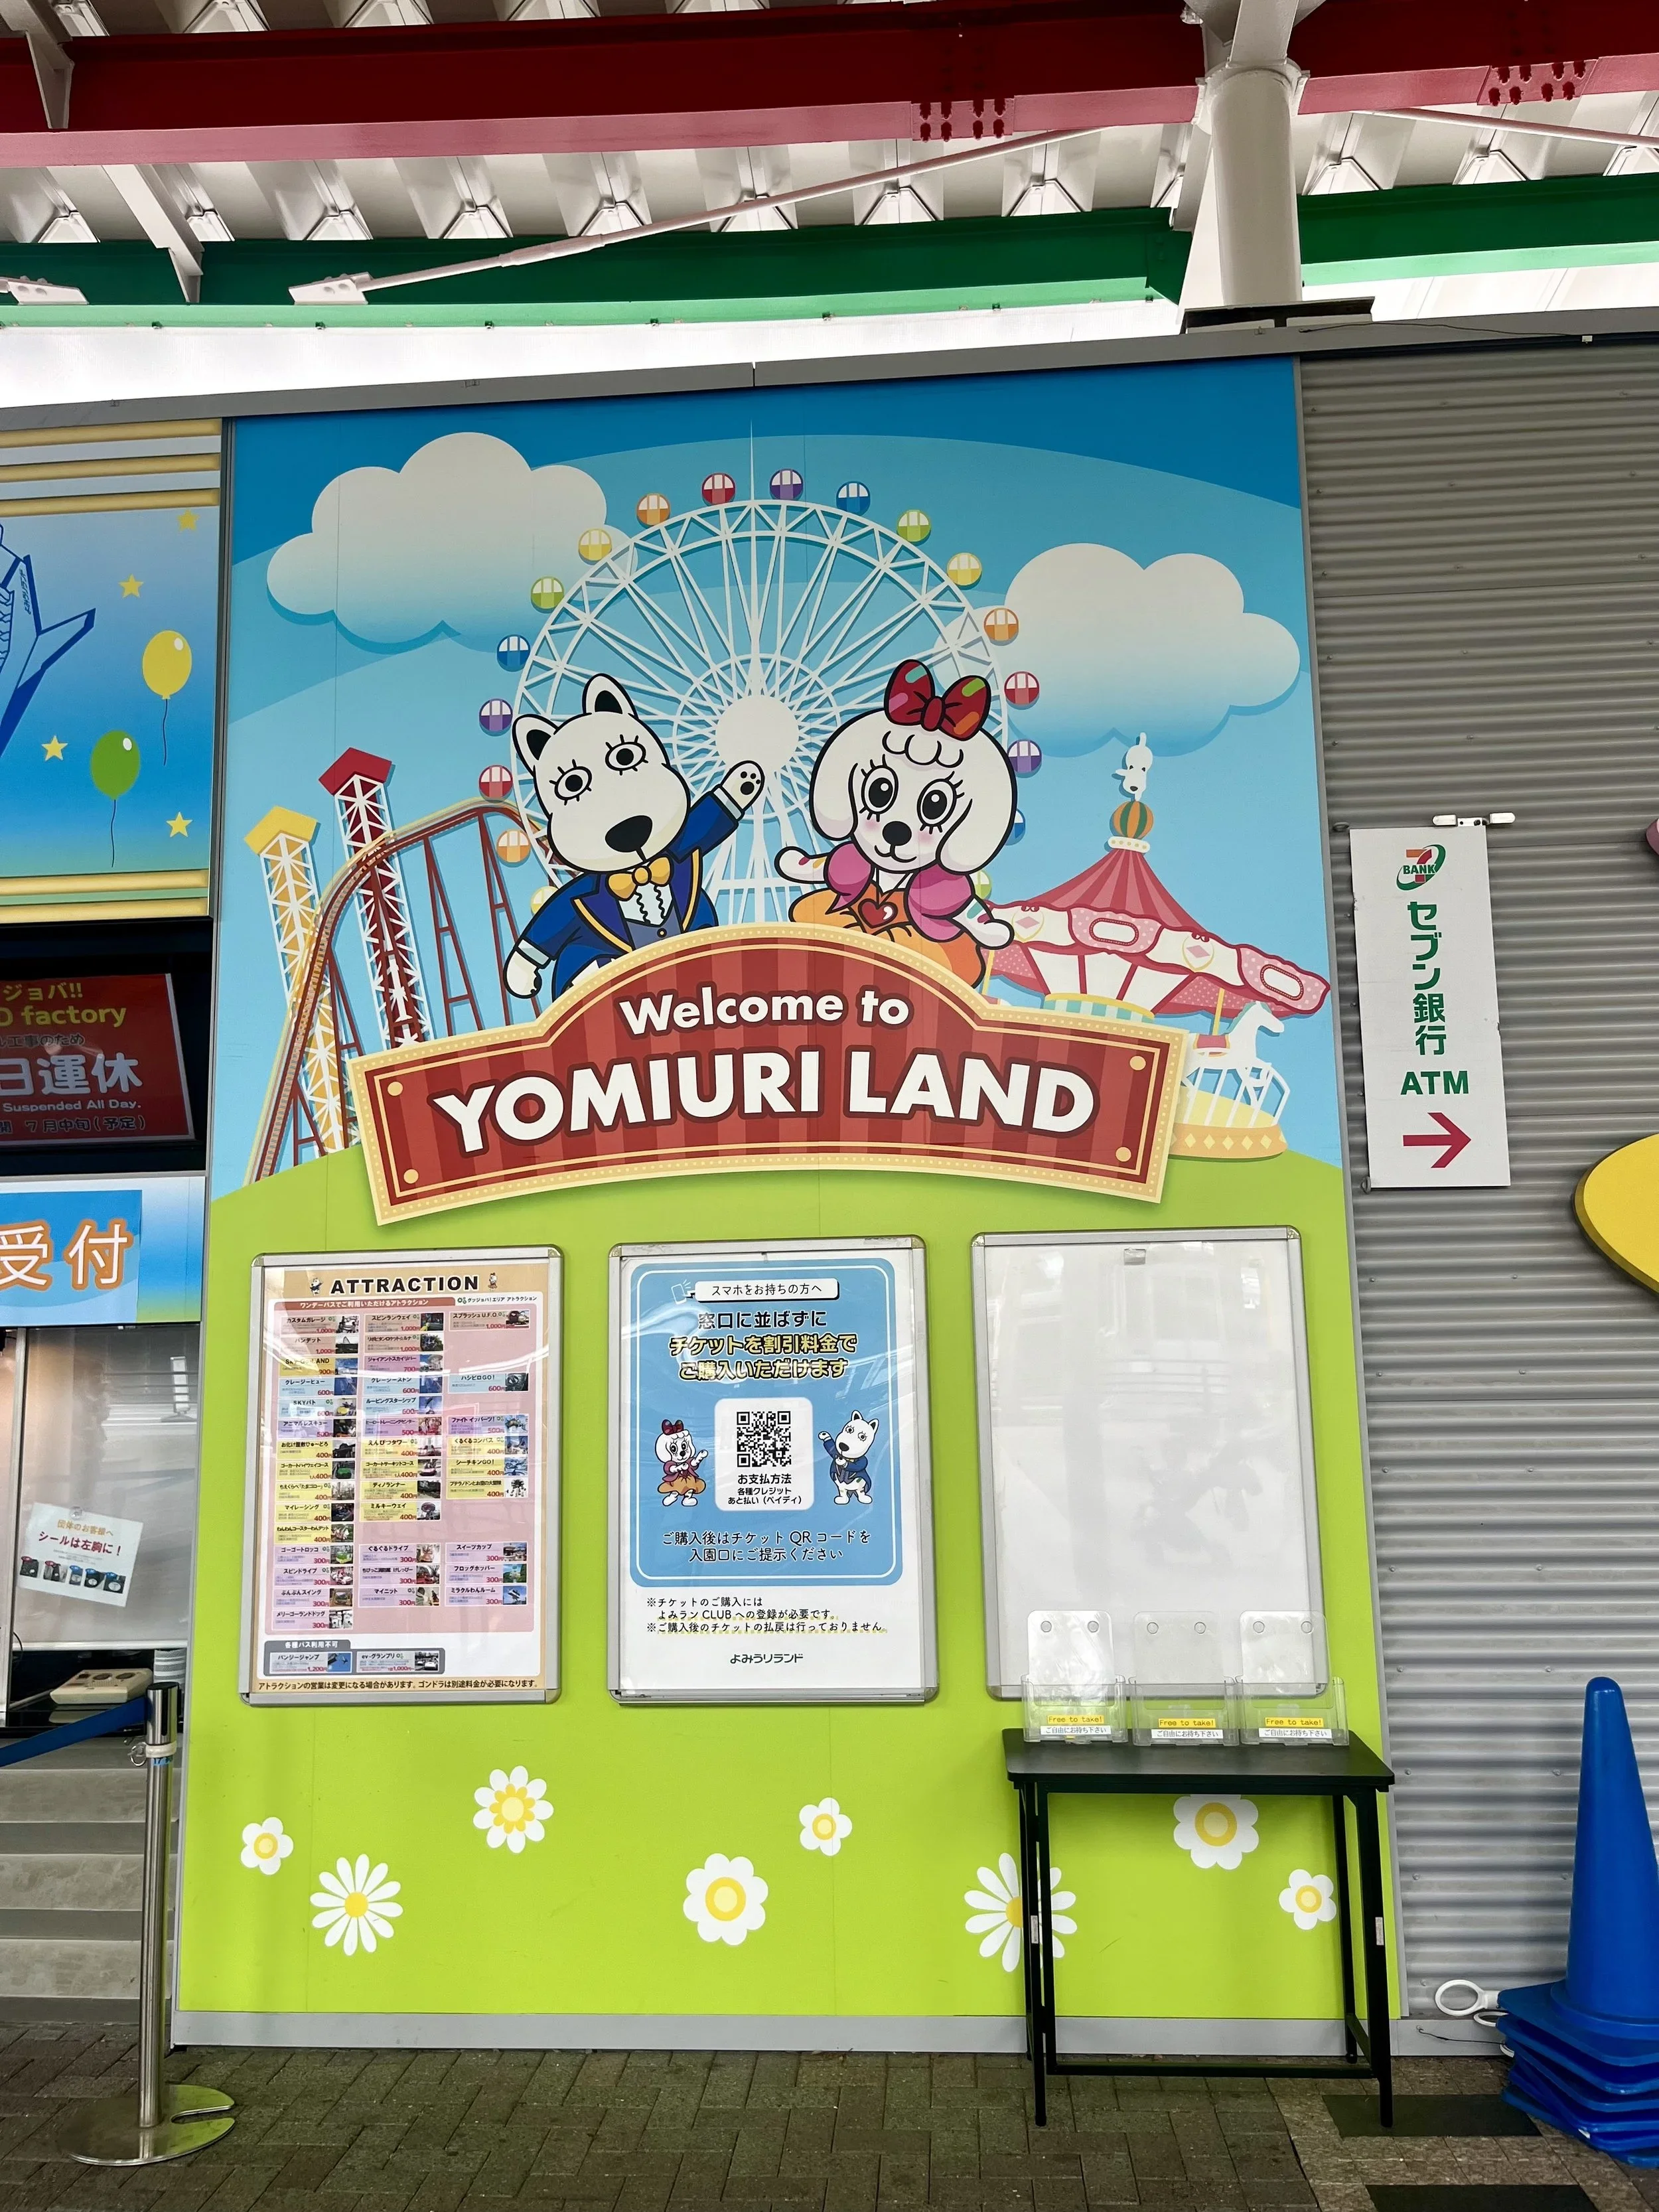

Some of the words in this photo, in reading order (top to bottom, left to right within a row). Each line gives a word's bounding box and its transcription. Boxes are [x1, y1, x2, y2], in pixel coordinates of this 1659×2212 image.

[1403, 864, 1435, 874] BANK
[1407, 901, 1446, 1056] セブン銀行
[21, 1005, 127, 1028] factory
[618, 986, 844, 1036] Welcome
[860, 986, 910, 1026] to
[1400, 1070, 1470, 1095] ATM
[3, 1100, 82, 1113] Suspended
[87, 1099, 105, 1110] All
[109, 1098, 142, 1110] Day.
[433, 1050, 820, 1153] YOMIURI
[848, 1051, 1096, 1134] LAND
[0, 1222, 130, 1288] 受付
[330, 1275, 479, 1295] ATTRACTION
[711, 1282, 822, 1297] スマホをお持ちの方へ
[300, 1299, 429, 1309] ワンデーパスでご利用いただけるアトラクション
[698, 1310, 827, 1329] 窓口に並ばずに
[670, 1334, 857, 1357] チケットを割引料金で
[679, 1359, 848, 1382] ご購入いただけます
[737, 1473, 792, 1485] お支払方法
[737, 1487, 792, 1496] 各種クレジット
[688, 1548, 843, 1563] 入園口にご提示ください
[729, 1653, 804, 1665] よみうりランド
[1264, 1729, 1327, 1737] ご自由にお持ち下さい
